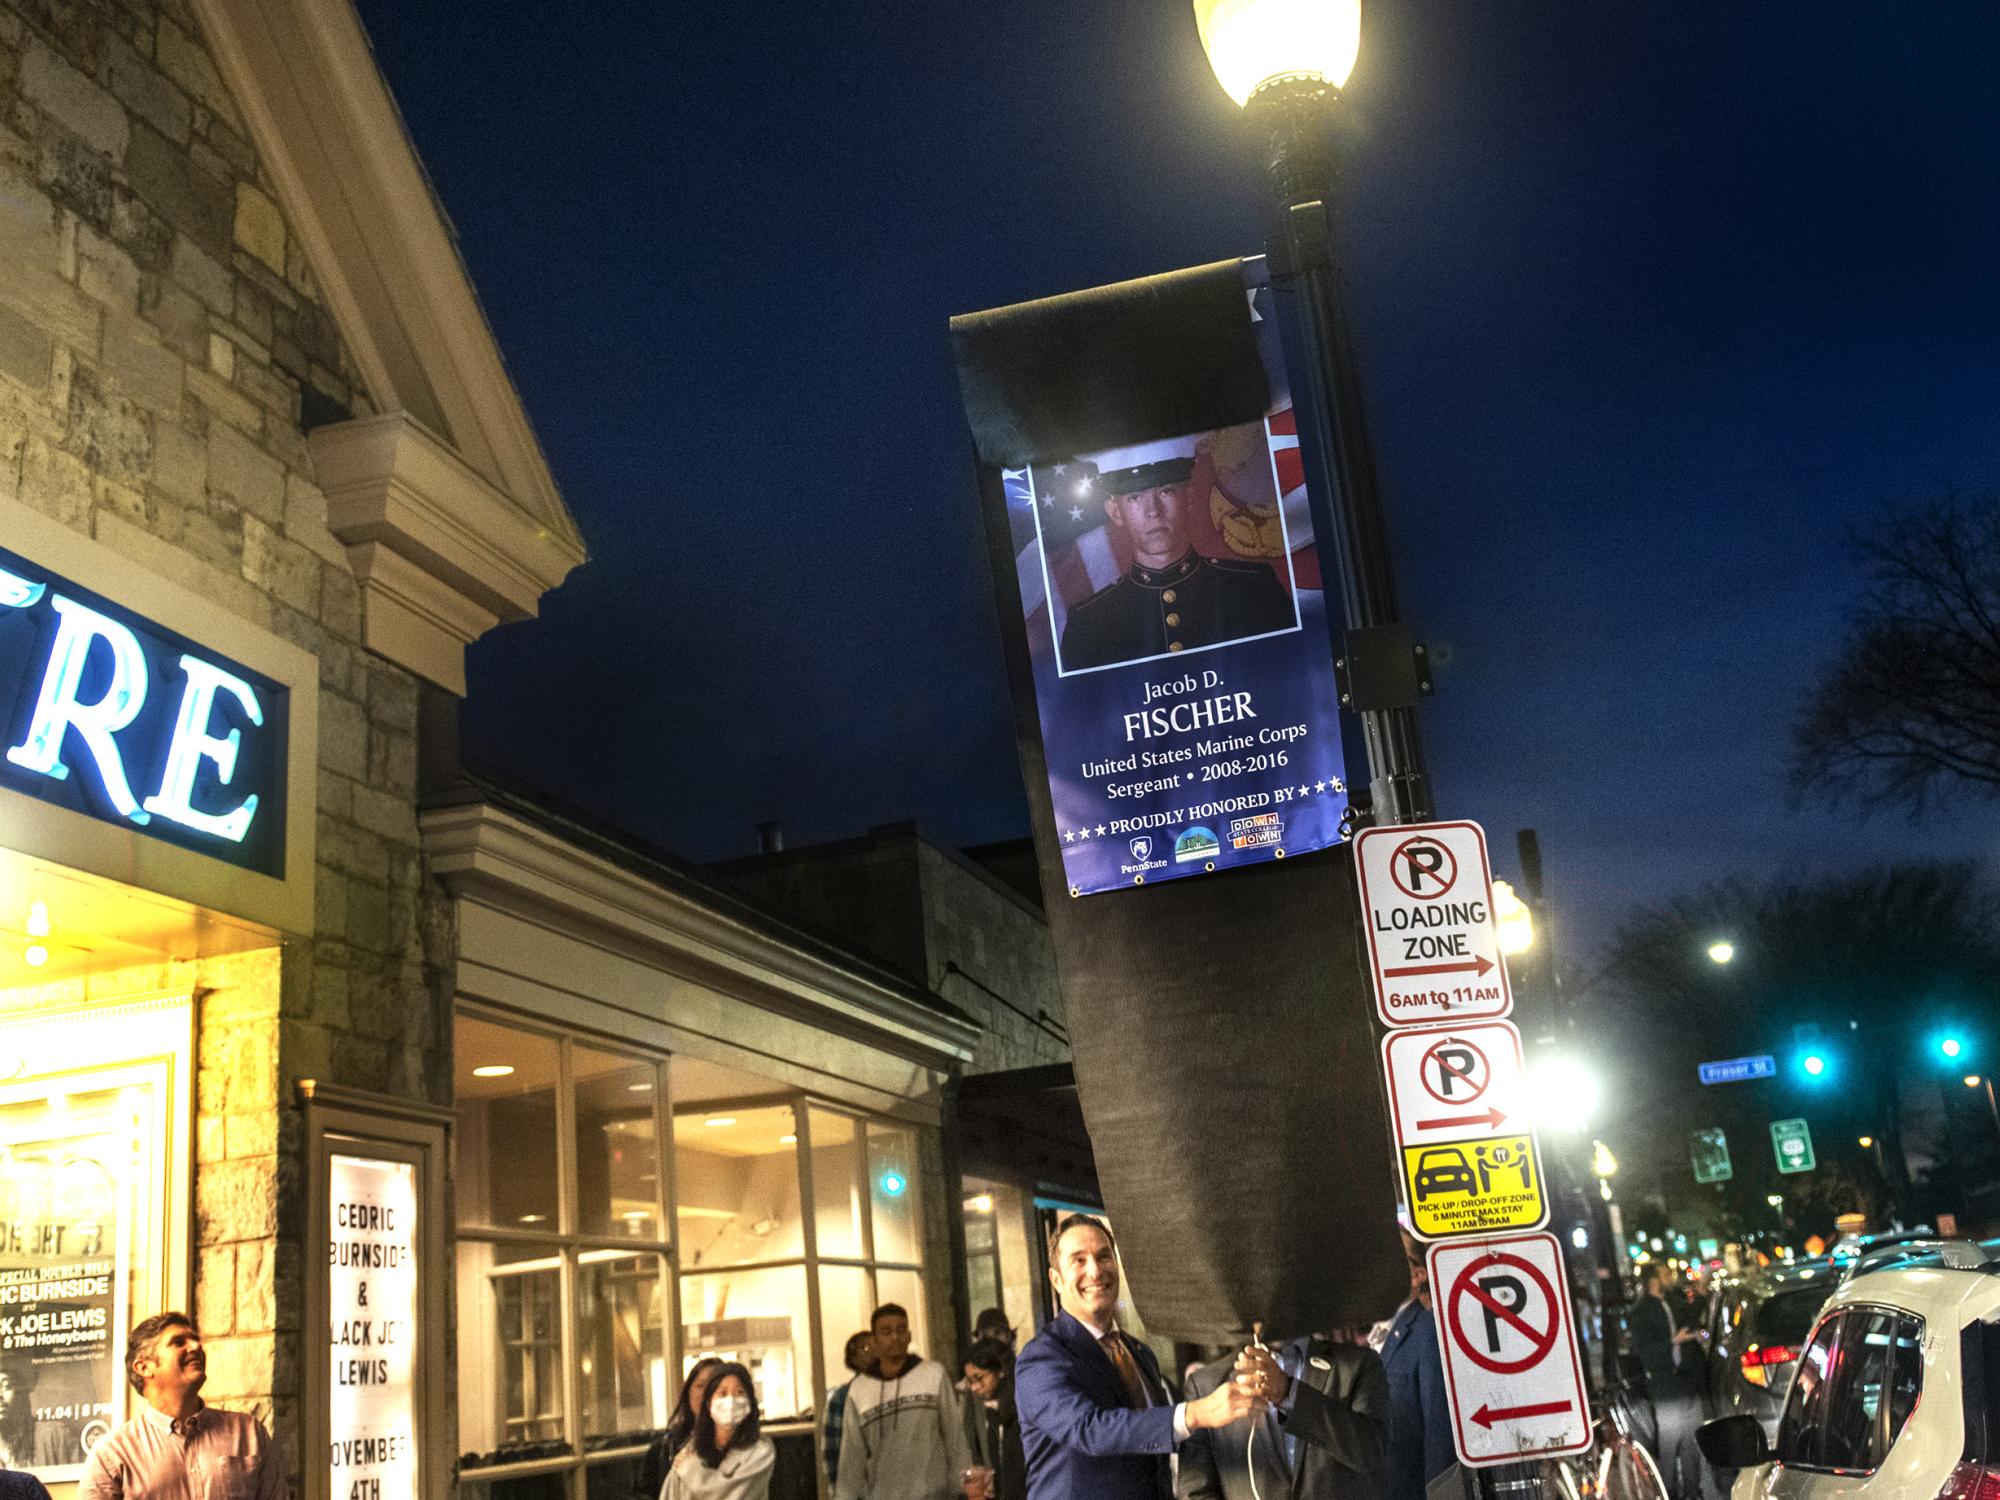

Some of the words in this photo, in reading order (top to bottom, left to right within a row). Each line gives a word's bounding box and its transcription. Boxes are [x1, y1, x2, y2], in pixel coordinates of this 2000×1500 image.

[1143, 673, 1197, 704] Jacob
[1202, 670, 1225, 689] D.
[1123, 691, 1257, 741] FISCHER
[1082, 754, 1138, 779] United
[1141, 747, 1192, 768] States
[1196, 734, 1254, 758] Marine
[1258, 722, 1308, 745] Corps
[1107, 774, 1181, 799] Sergeant
[1201, 749, 1289, 783] 2008-2016
[1110, 808, 1184, 835] PROUDLY
[1188, 792, 1270, 820] HONORED
[1274, 786, 1295, 804] BY
[1233, 815, 1277, 830] DOWN
[1374, 901, 1487, 932] LOADING
[1402, 934, 1471, 960] ZONE
[1390, 992, 1428, 1008] 6AM
[1430, 989, 1449, 1006] to
[1452, 987, 1500, 1003] 11AM
[1510, 1193, 1536, 1203] ZONE
[338, 1203, 395, 1231] CEDRIC
[1433, 1213, 1440, 1221] 5
[1440, 1209, 1477, 1221] MINUTE
[1479, 1207, 1501, 1217] MAX
[1501, 1205, 1524, 1214] STAY
[20, 1276, 109, 1302] BURNSIDE
[357, 1281, 368, 1306] &
[15, 1313, 50, 1334] JOE
[51, 1308, 106, 1330] LEWIS
[14, 1333, 36, 1348] The
[339, 1359, 388, 1385] LEWIS
[36, 1405, 73, 1421] 11.04
[330, 1436, 406, 1467] OVEMBE
[350, 1478, 380, 1500] 4TH
